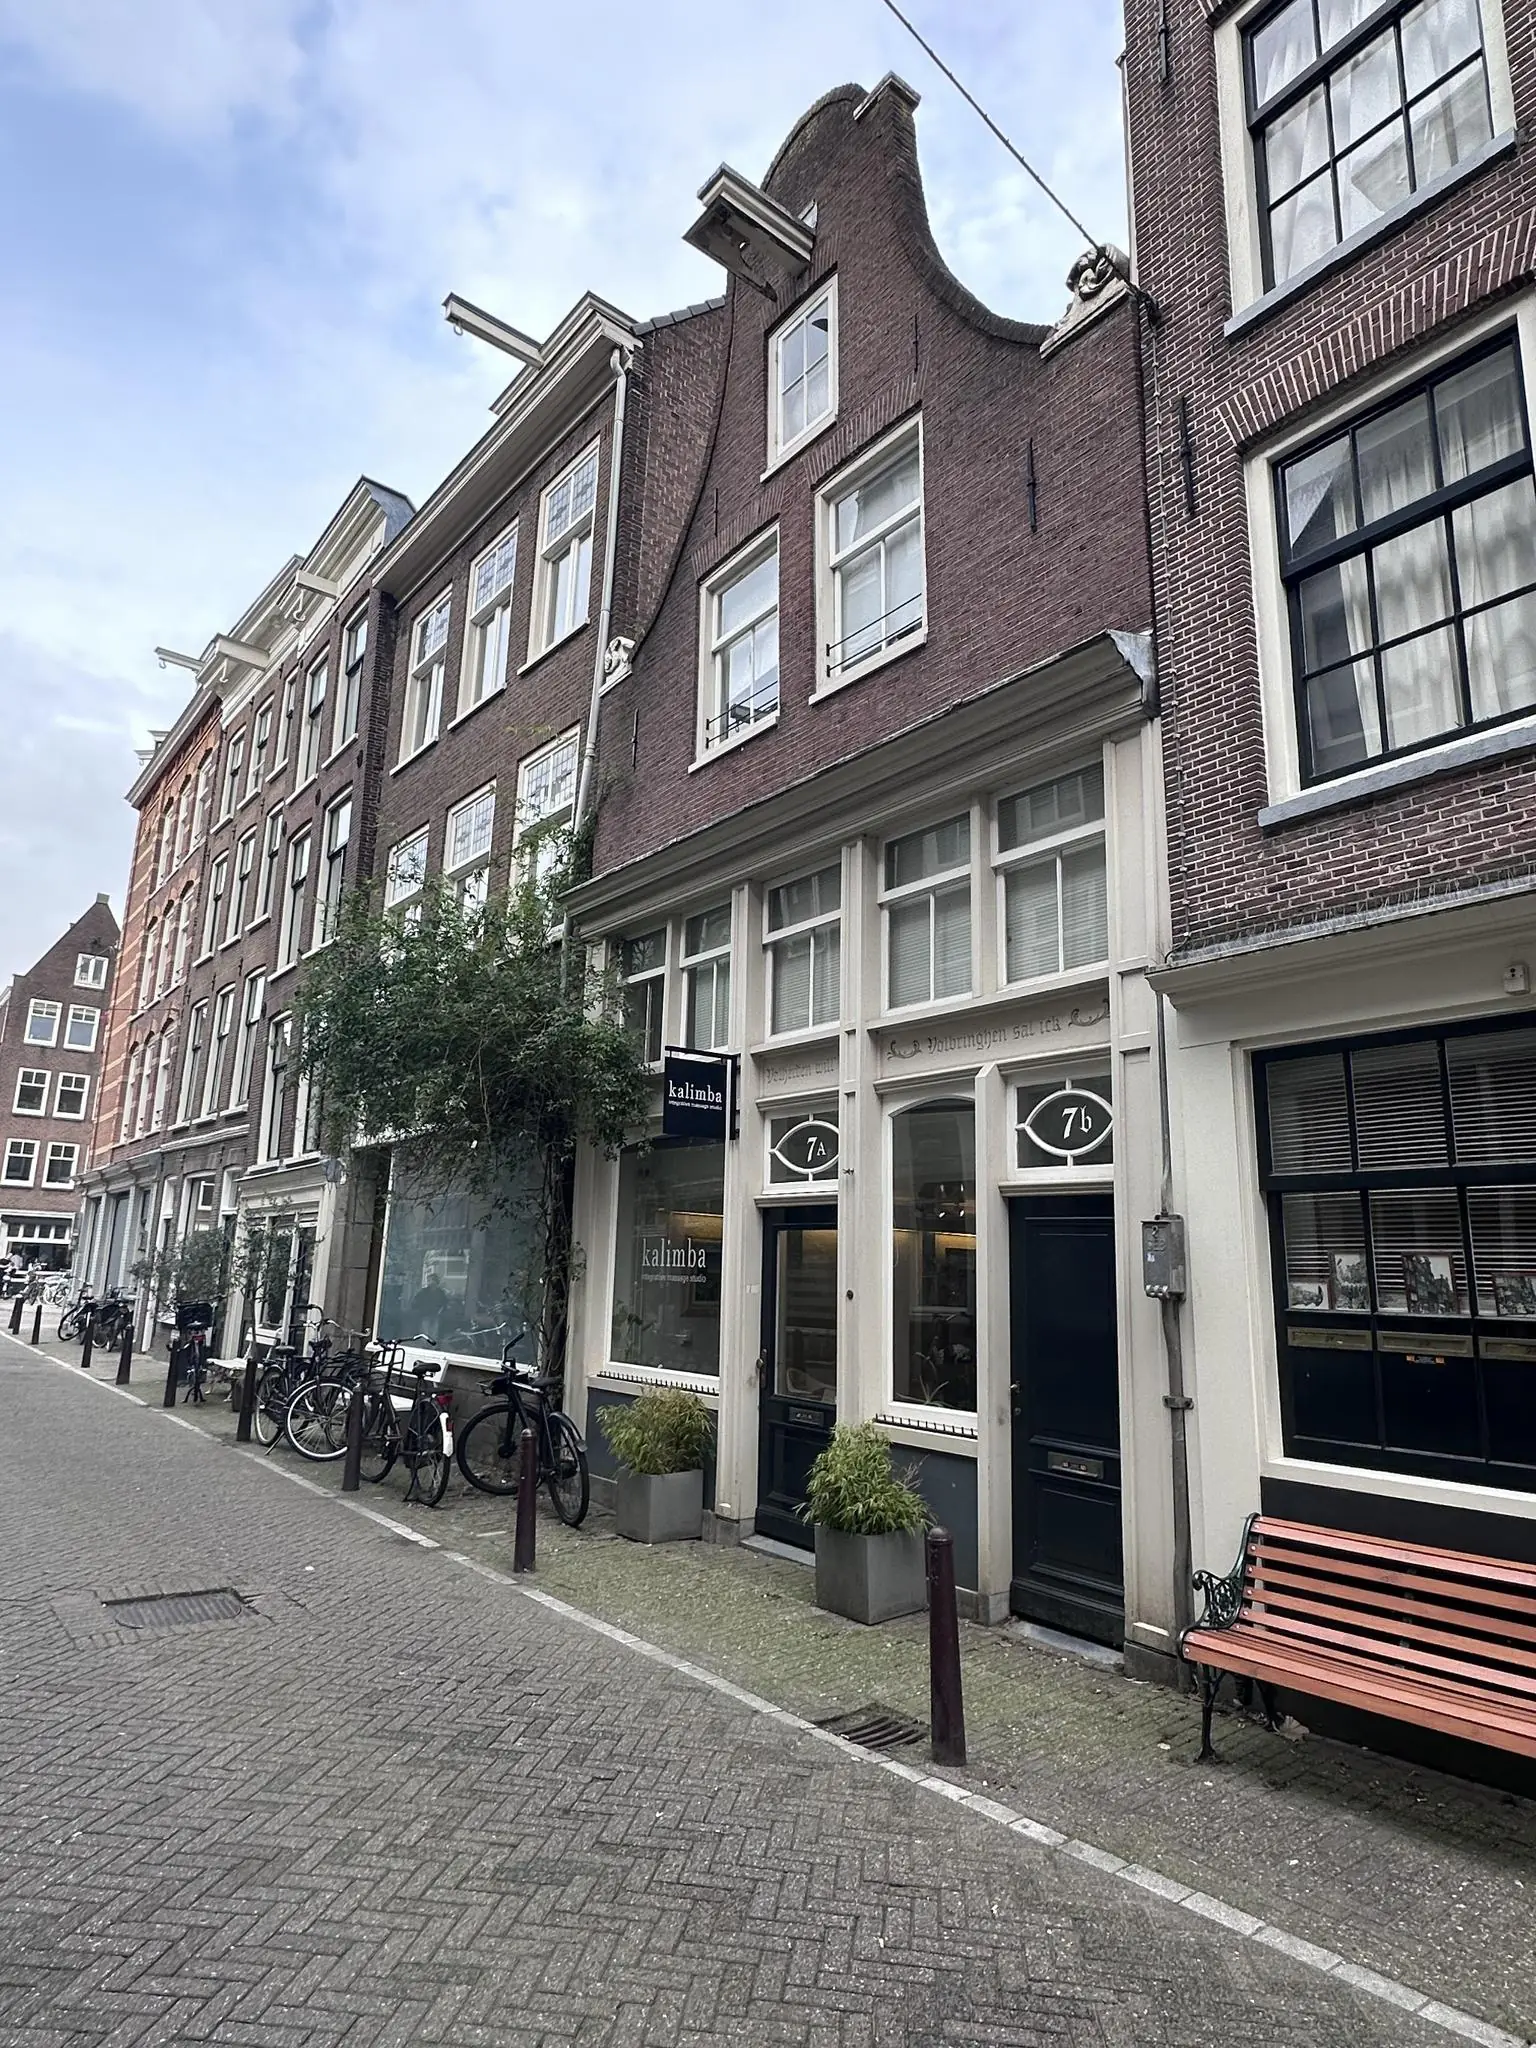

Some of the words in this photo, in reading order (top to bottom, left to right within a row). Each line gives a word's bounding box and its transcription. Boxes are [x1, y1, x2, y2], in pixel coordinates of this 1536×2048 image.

[1013, 1022, 1035, 1040] sal
[1040, 1016, 1062, 1035] ick
[668, 1080, 722, 1103] kalimba
[1061, 1105, 1092, 1139] 7b
[807, 1136, 827, 1163] 7A
[642, 1237, 706, 1268] kalimba
